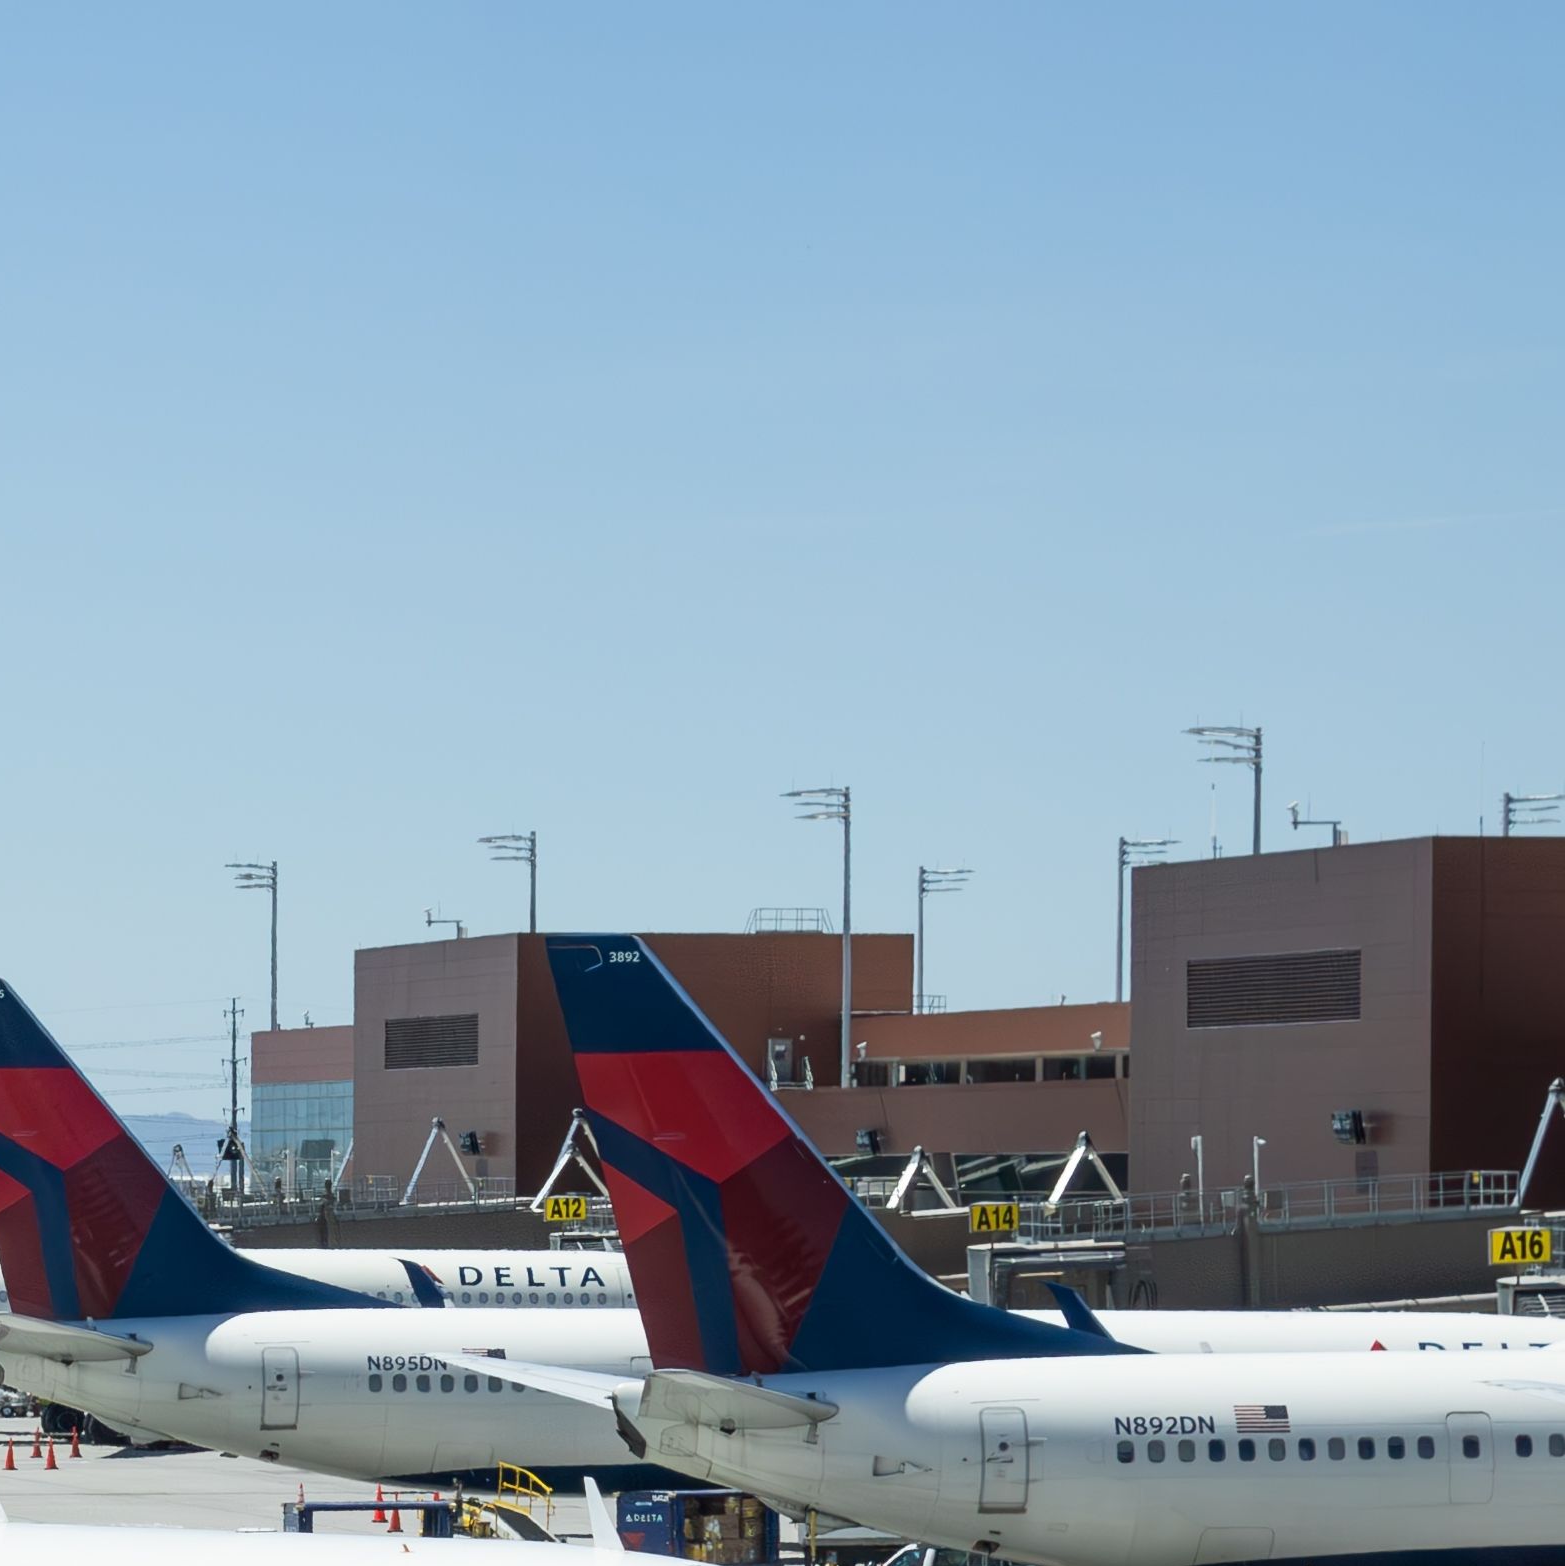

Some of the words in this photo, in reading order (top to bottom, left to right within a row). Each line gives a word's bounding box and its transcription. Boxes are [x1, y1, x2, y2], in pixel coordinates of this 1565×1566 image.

[608, 950, 641, 964] 3892
[550, 1197, 583, 1220] A12
[976, 1207, 1016, 1231] A14
[1499, 1231, 1543, 1261] A16
[459, 1266, 606, 1288] DELTA
[367, 1356, 448, 1371] N895DN
[1114, 1415, 1216, 1436] N892DN
